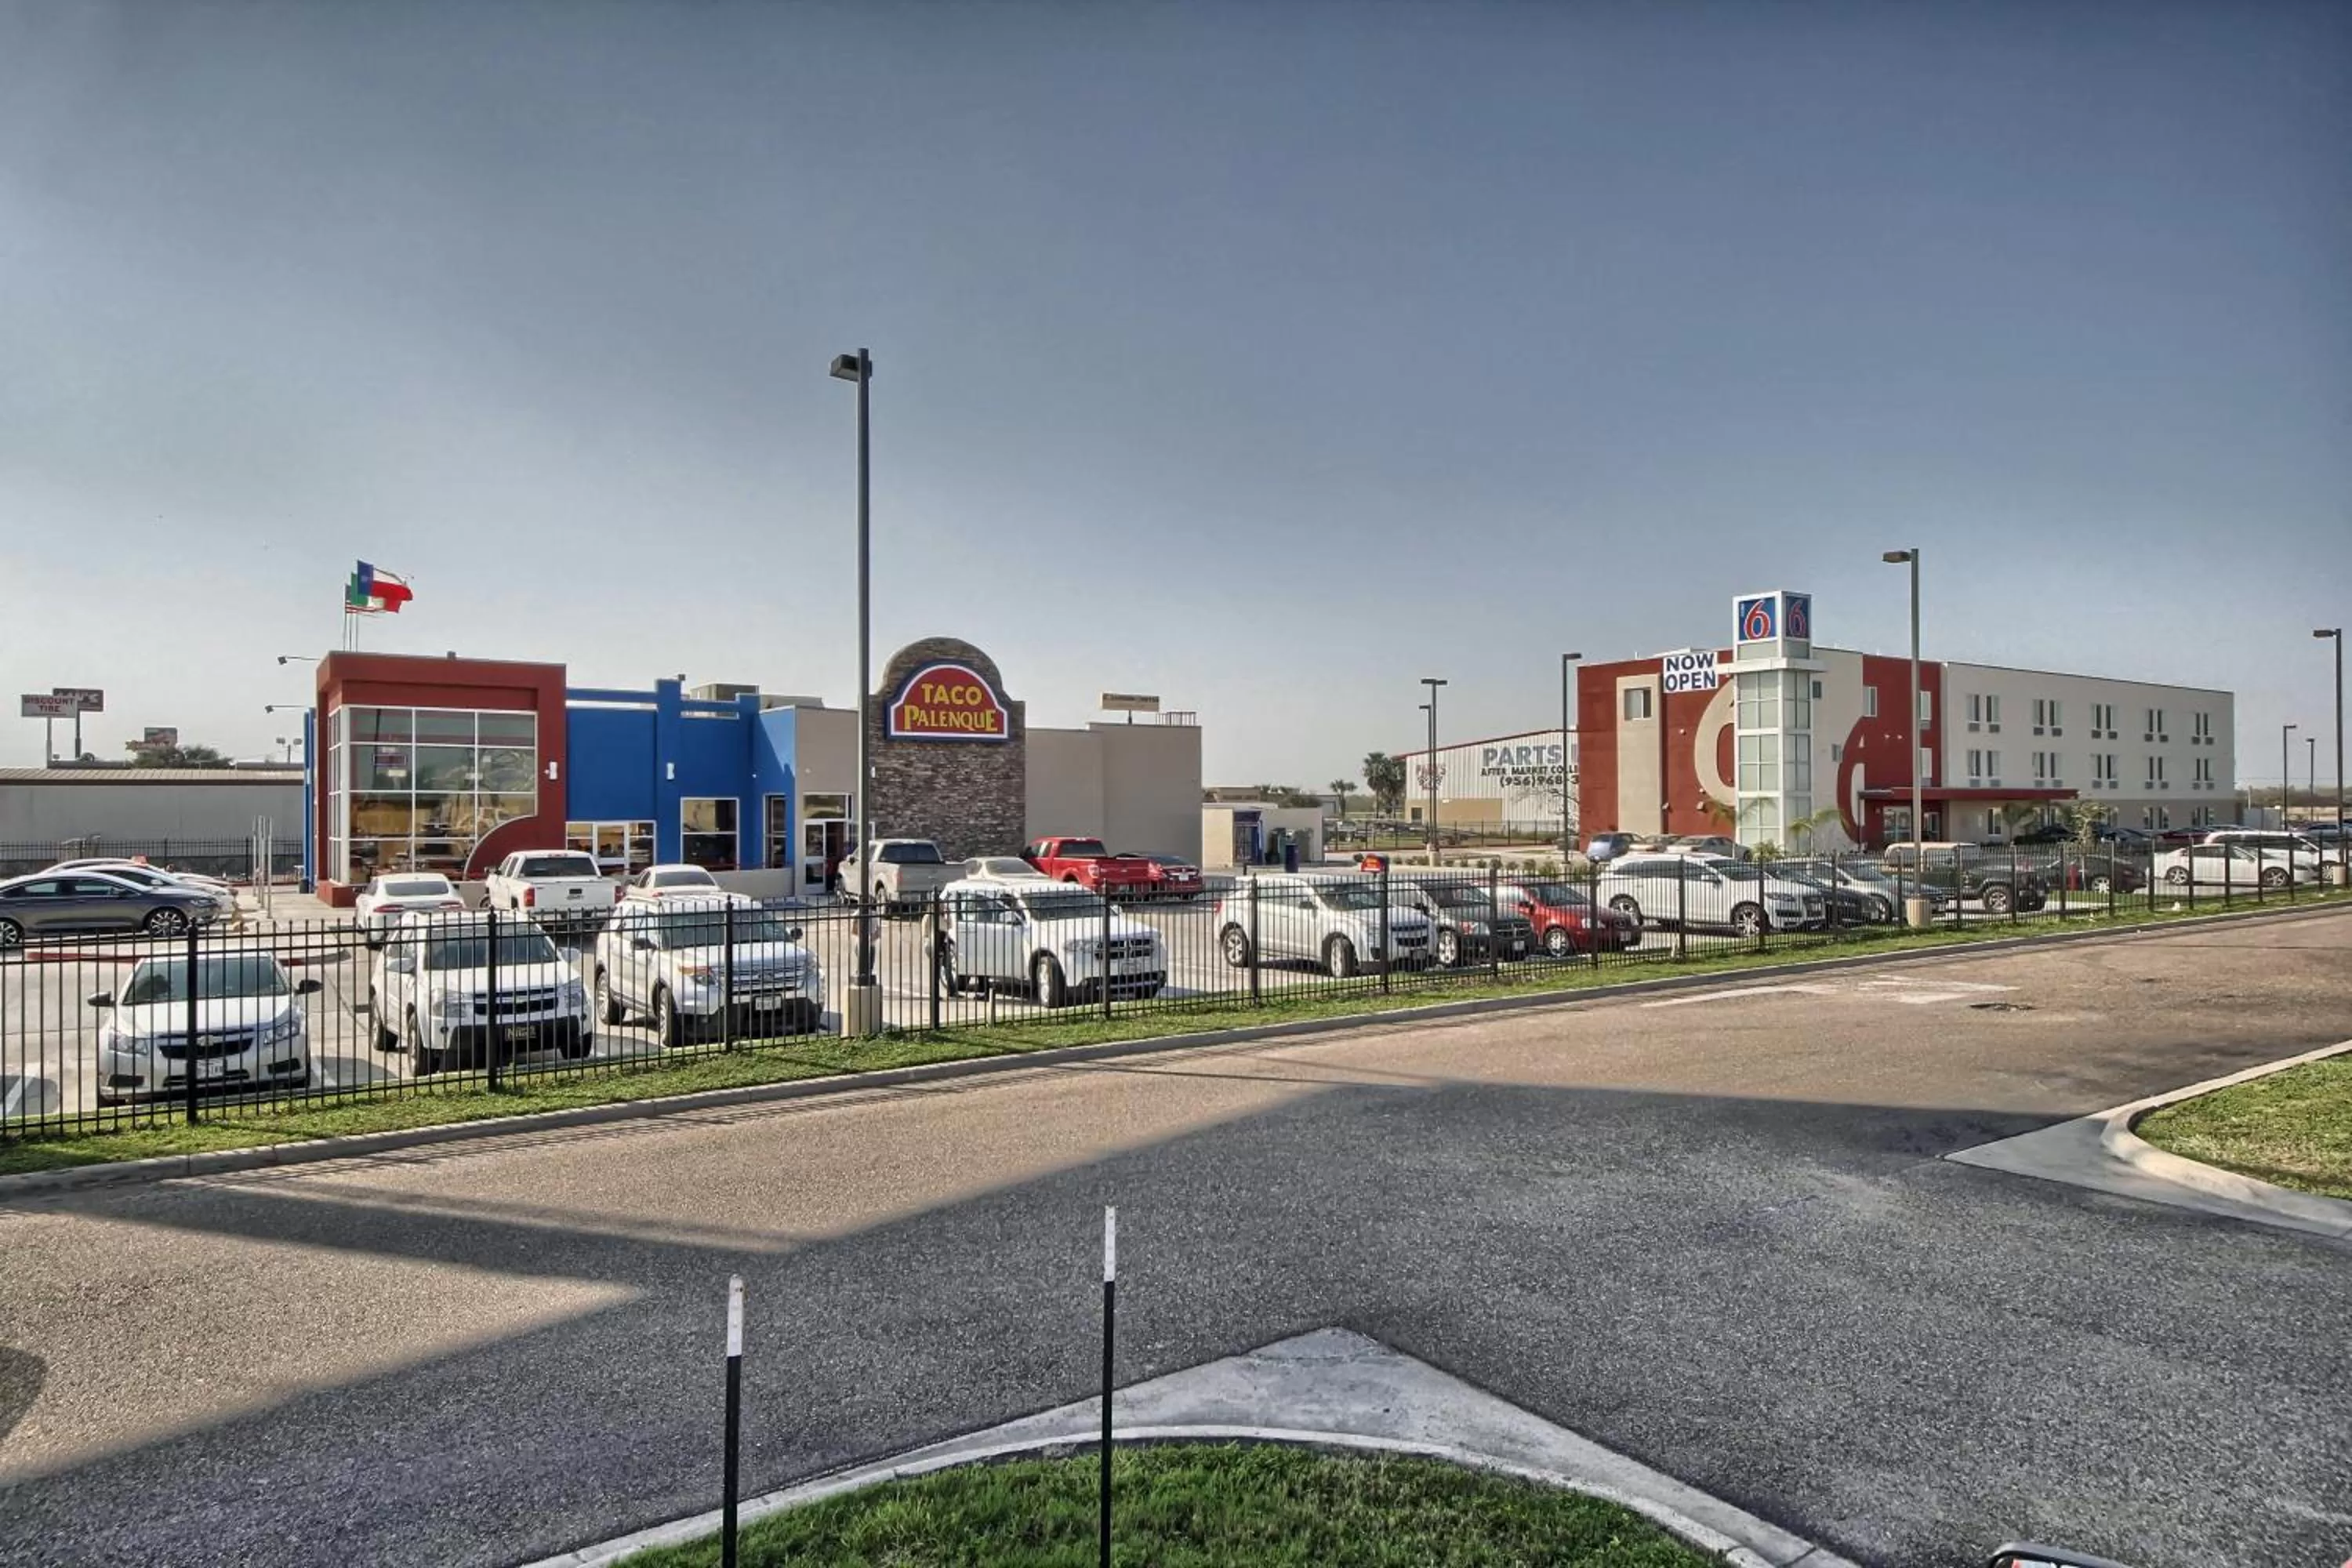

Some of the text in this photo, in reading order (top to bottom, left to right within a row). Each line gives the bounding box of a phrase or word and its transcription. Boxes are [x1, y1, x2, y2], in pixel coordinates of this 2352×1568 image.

[1744, 600, 1770, 641] 6
[1666, 653, 1715, 672] NOW
[1665, 670, 1715, 691] OPEN
[24, 696, 74, 706] DISCOUNT
[921, 683, 982, 706] TACO
[904, 704, 998, 731] PALENQUE
[1483, 745, 1563, 766] PARTS
[1480, 768, 1507, 776] AFTER
[1512, 766, 1548, 775] MARKET
